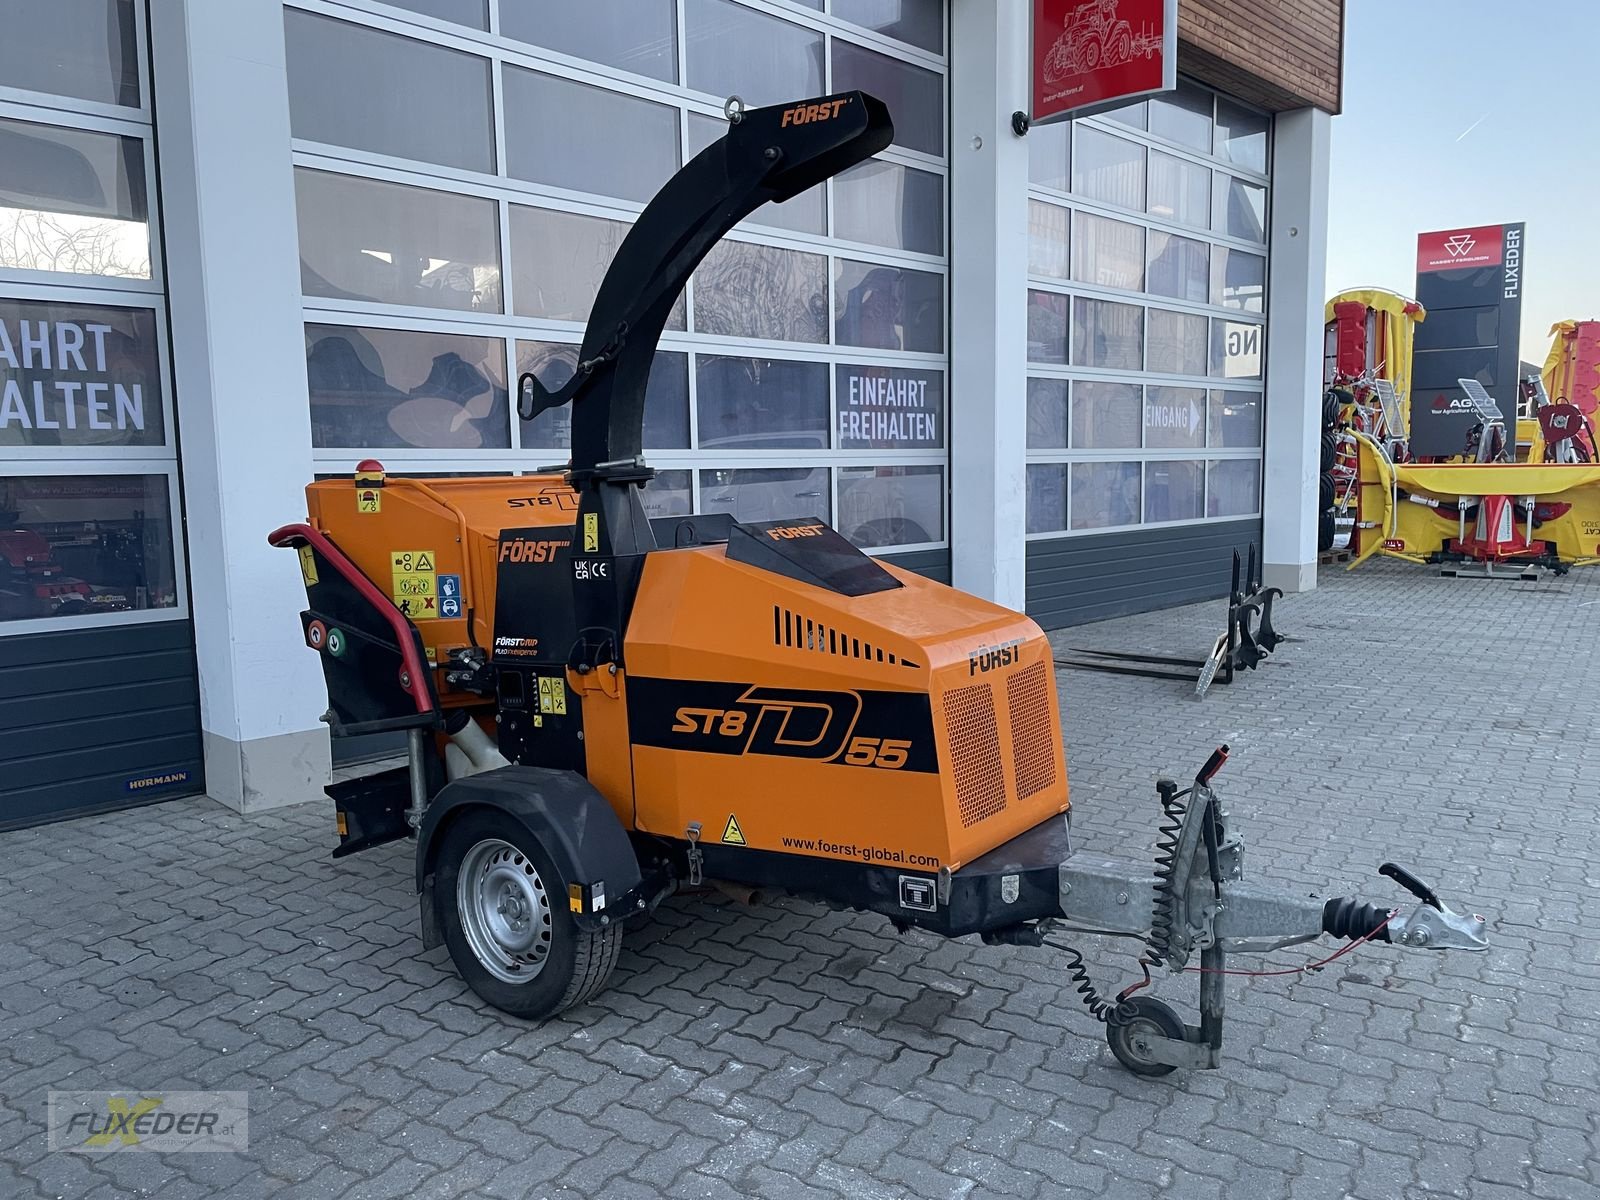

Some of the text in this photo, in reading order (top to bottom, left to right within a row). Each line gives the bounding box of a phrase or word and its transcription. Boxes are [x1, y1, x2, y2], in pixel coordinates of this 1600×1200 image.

[781, 99, 847, 128] FÖRST
[1504, 229, 1521, 299] FLIXEDER
[0, 379, 145, 430] ALTEN
[849, 376, 927, 408] EINFAHRT
[839, 411, 936, 440] FREIHALTEN
[1146, 405, 1187, 428] EINGANG
[507, 496, 553, 508] ST8
[766, 524, 824, 541] FÖRST
[499, 538, 563, 563] FÖRST
[968, 638, 1022, 676] FÖRST
[844, 736, 913, 769] 55
[782, 836, 940, 868] www.foerst-global.com
